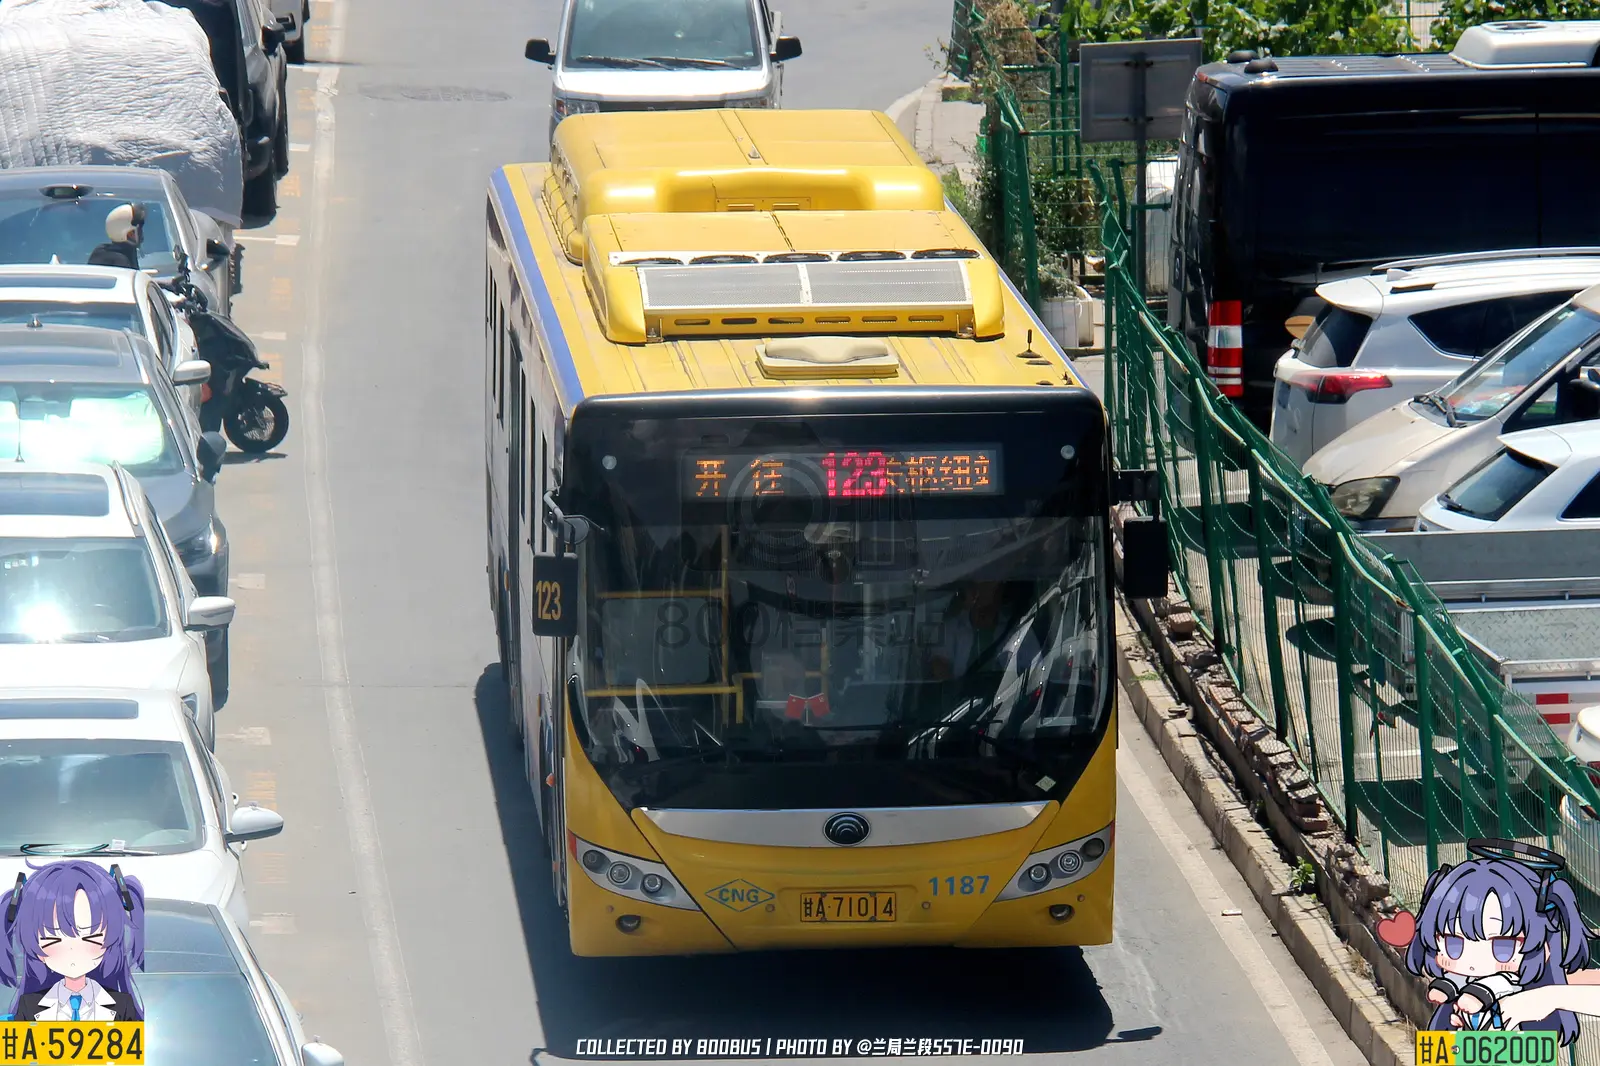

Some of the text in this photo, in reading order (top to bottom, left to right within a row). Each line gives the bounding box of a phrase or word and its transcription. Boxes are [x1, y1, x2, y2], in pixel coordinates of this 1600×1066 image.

[821, 452, 887, 497] 123
[536, 580, 562, 620] 123
[718, 888, 760, 903] CNG
[928, 875, 990, 897] 1187
